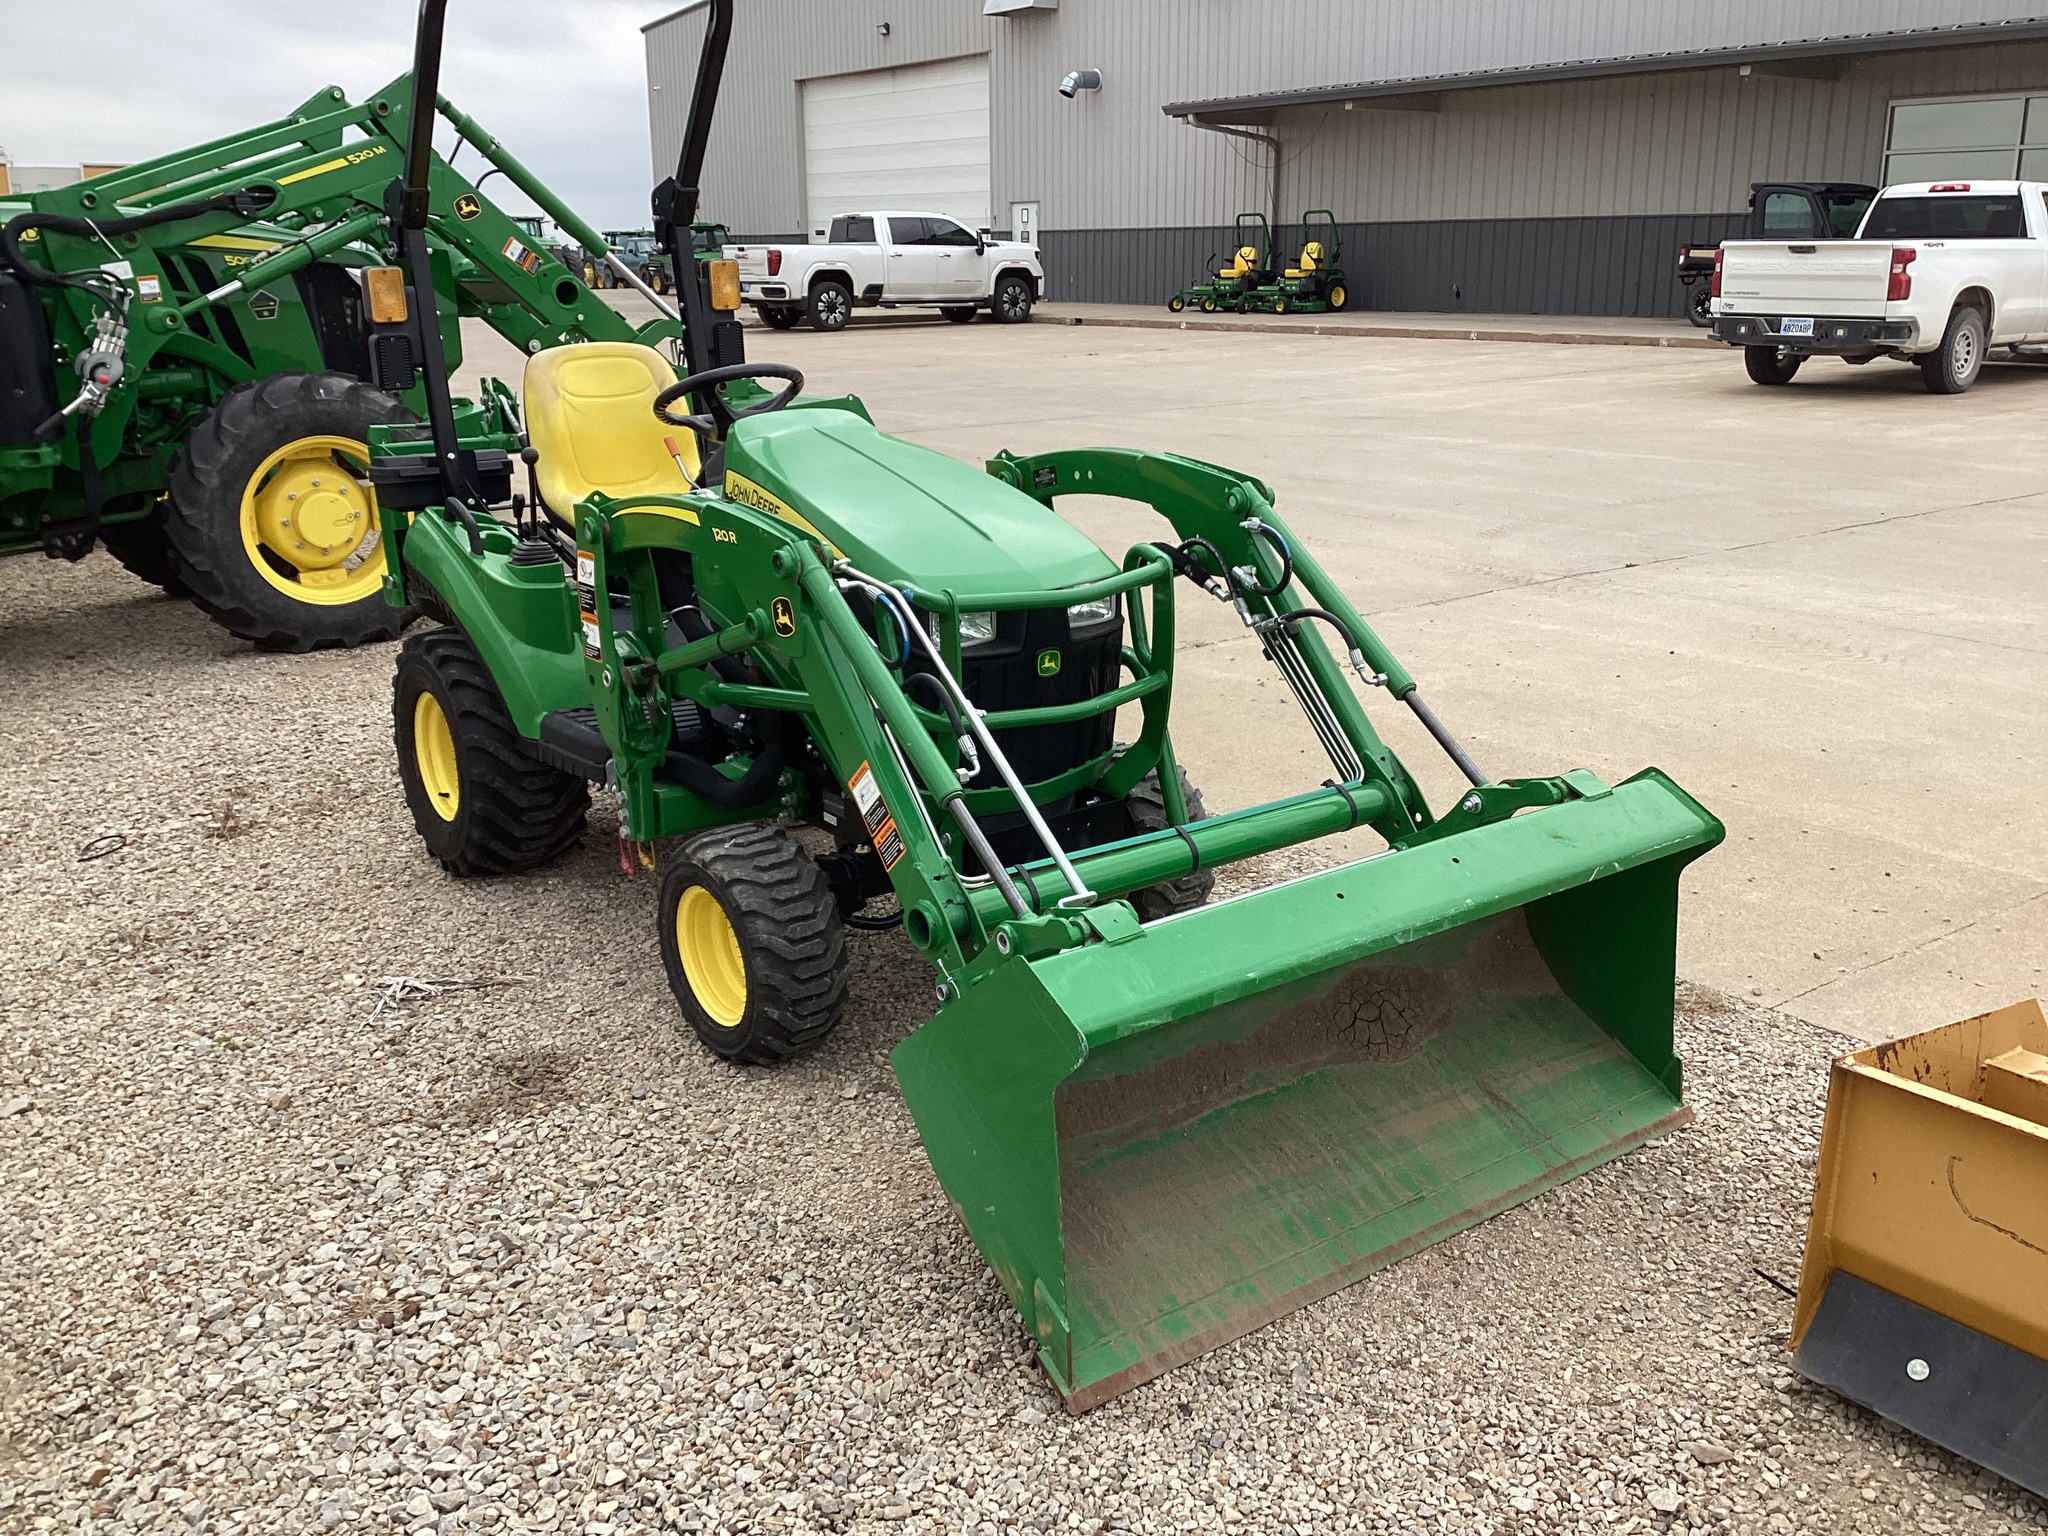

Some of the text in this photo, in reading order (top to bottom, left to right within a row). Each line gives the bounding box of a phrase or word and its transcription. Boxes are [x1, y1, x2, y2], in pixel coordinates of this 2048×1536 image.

[346, 145, 387, 164] 520 M
[727, 479, 782, 516] JOHN DEERE
